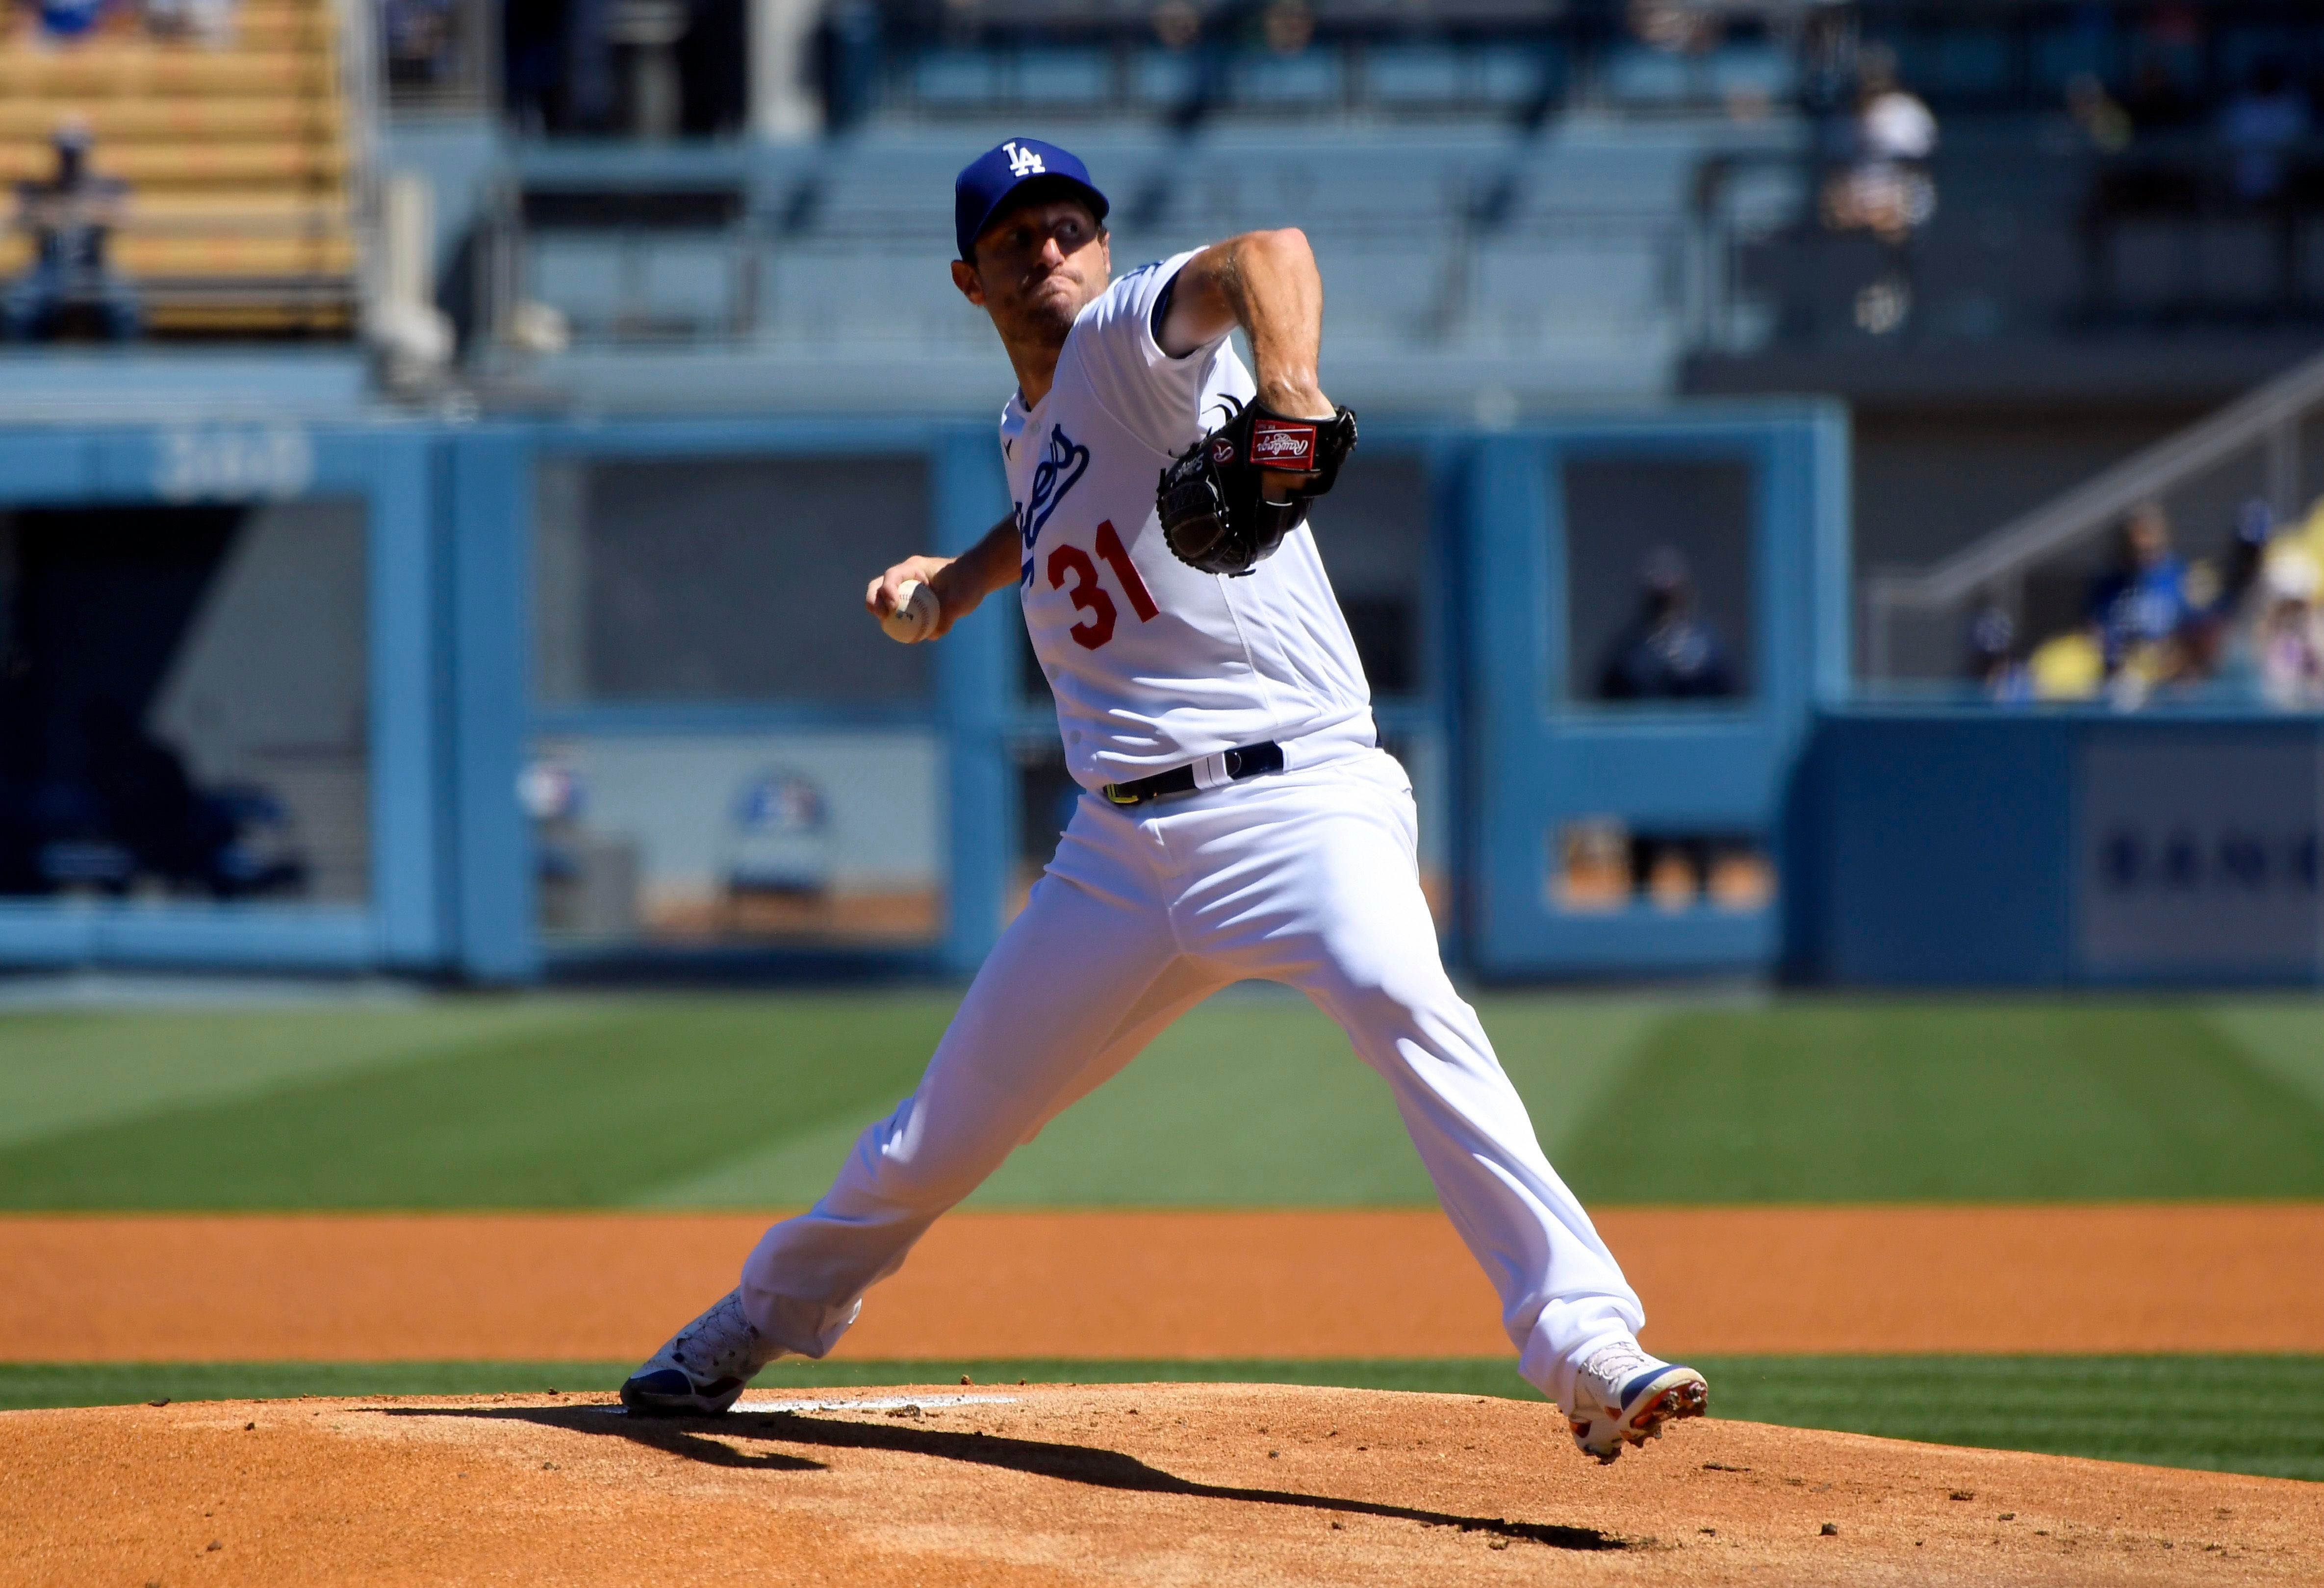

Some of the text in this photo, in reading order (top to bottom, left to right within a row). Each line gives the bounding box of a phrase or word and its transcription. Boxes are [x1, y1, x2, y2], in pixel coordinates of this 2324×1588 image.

[1003, 142, 1046, 177] LA
[1257, 436, 1308, 456] Rawlings
[1047, 519, 1160, 651] 31
